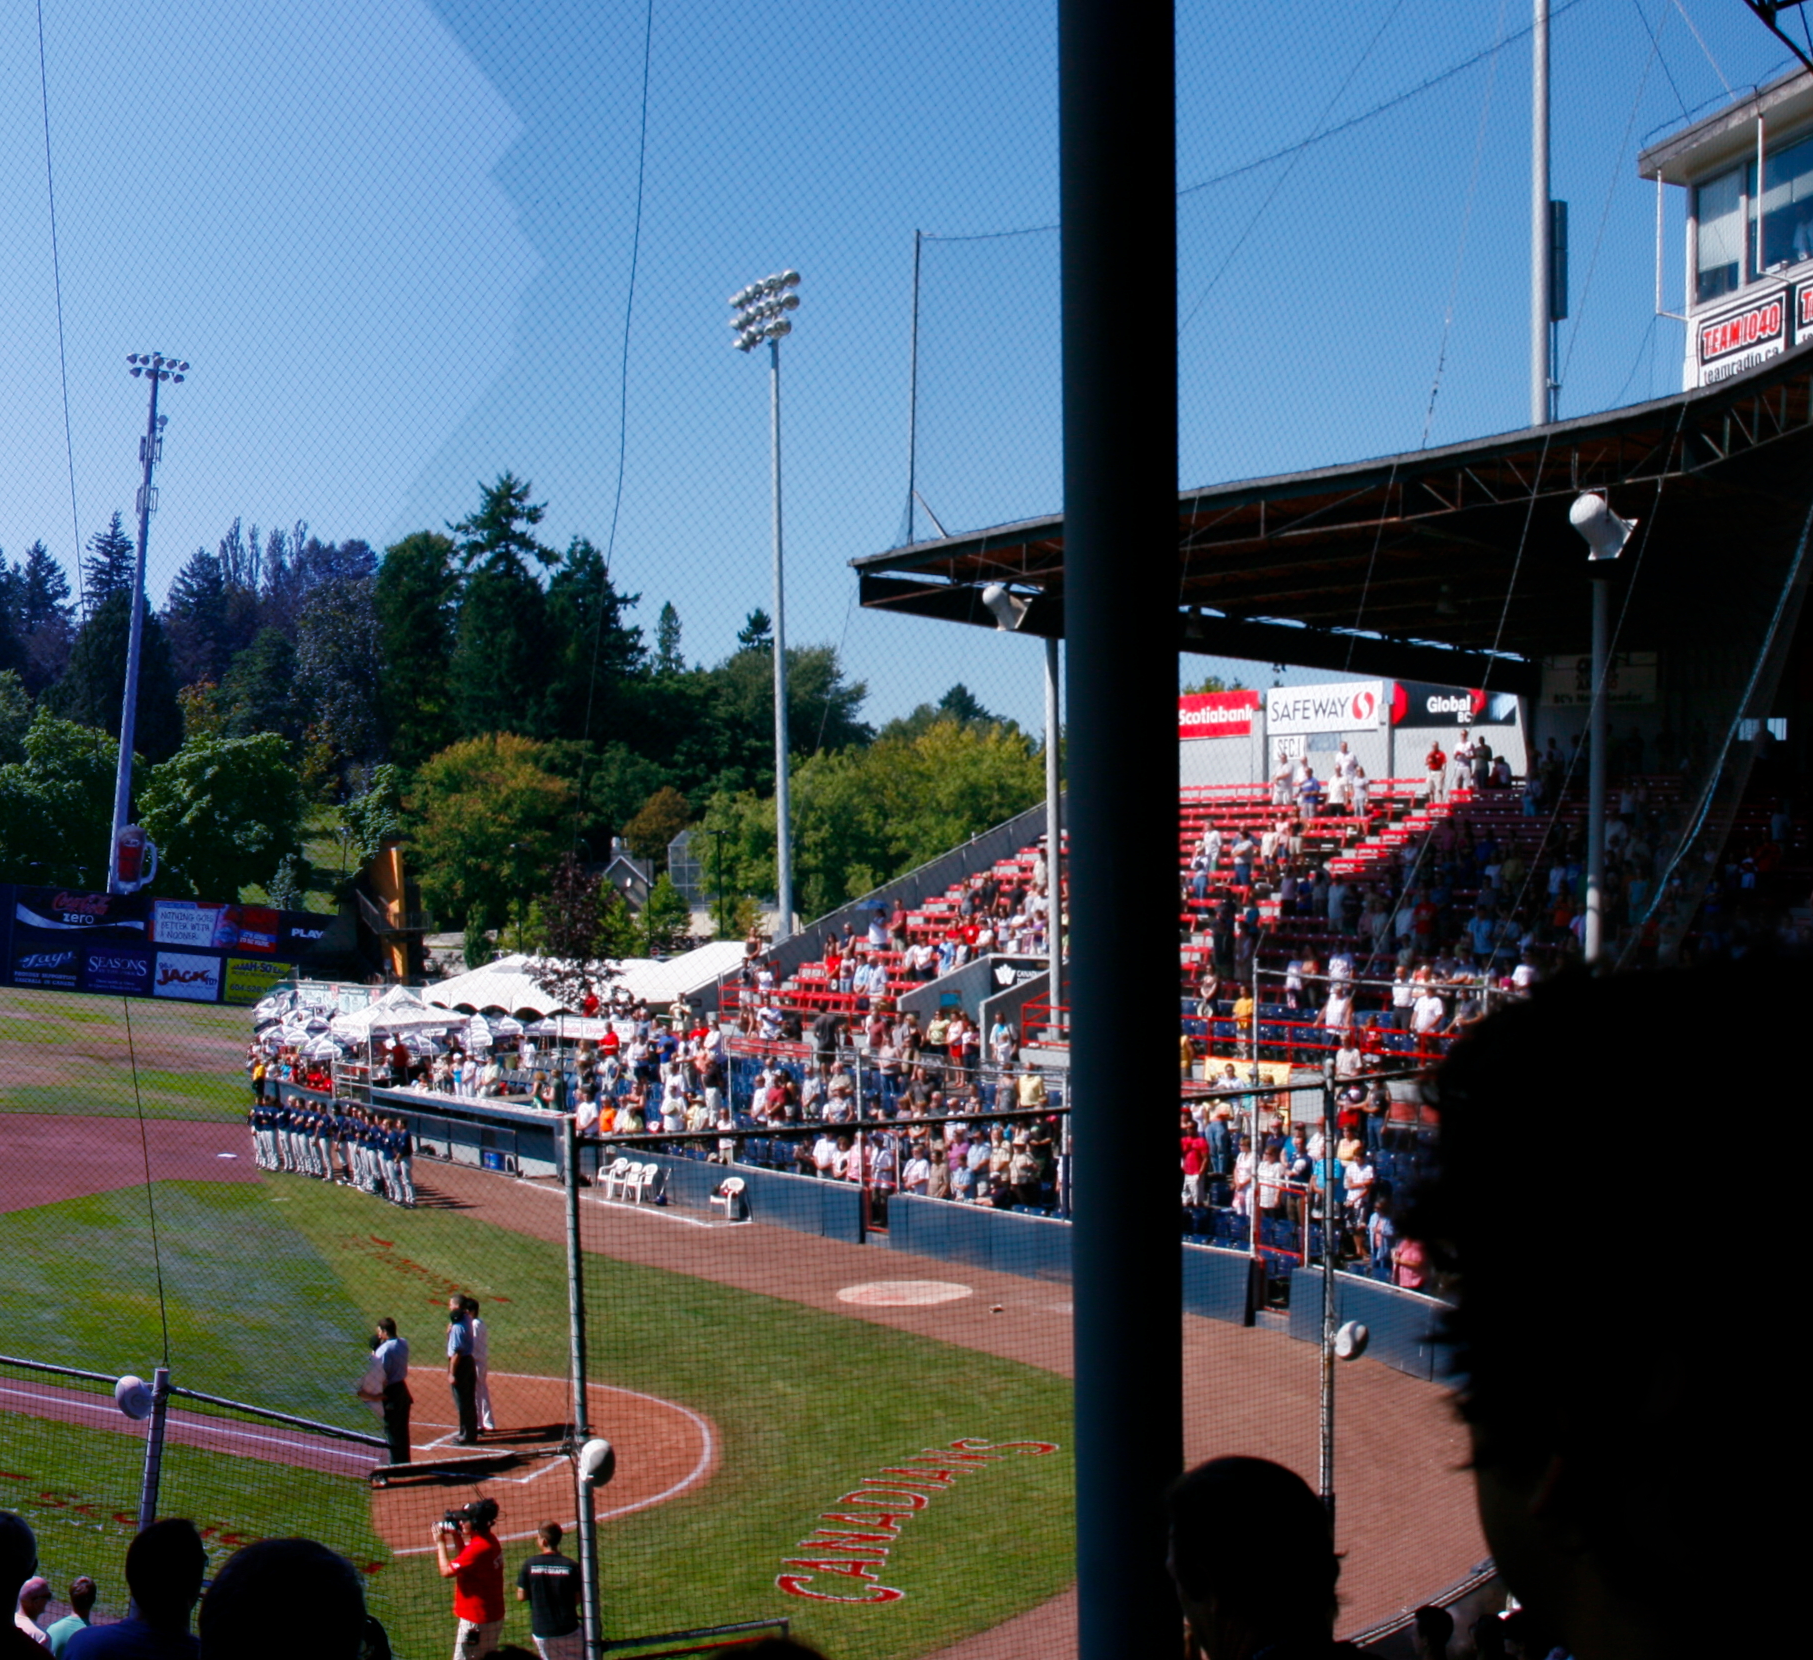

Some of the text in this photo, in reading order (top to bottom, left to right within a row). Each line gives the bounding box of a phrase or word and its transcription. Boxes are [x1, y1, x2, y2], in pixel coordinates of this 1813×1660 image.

[1702, 303, 1781, 358] TEAM 1040
[1272, 699, 1349, 722] SAFEWAY
[1426, 694, 1471, 713] Global
[1179, 704, 1254, 726] Scotiabank
[1457, 711, 1474, 723] BC
[62, 912, 95, 925] zero
[160, 911, 215, 922] NOTHING GOES
[160, 921, 210, 932] BETTER WITH
[19, 951, 75, 969] Jays
[88, 955, 147, 977] SEASONS
[157, 968, 210, 986] JACK
[775, 1437, 1060, 1604] CANADIANS
